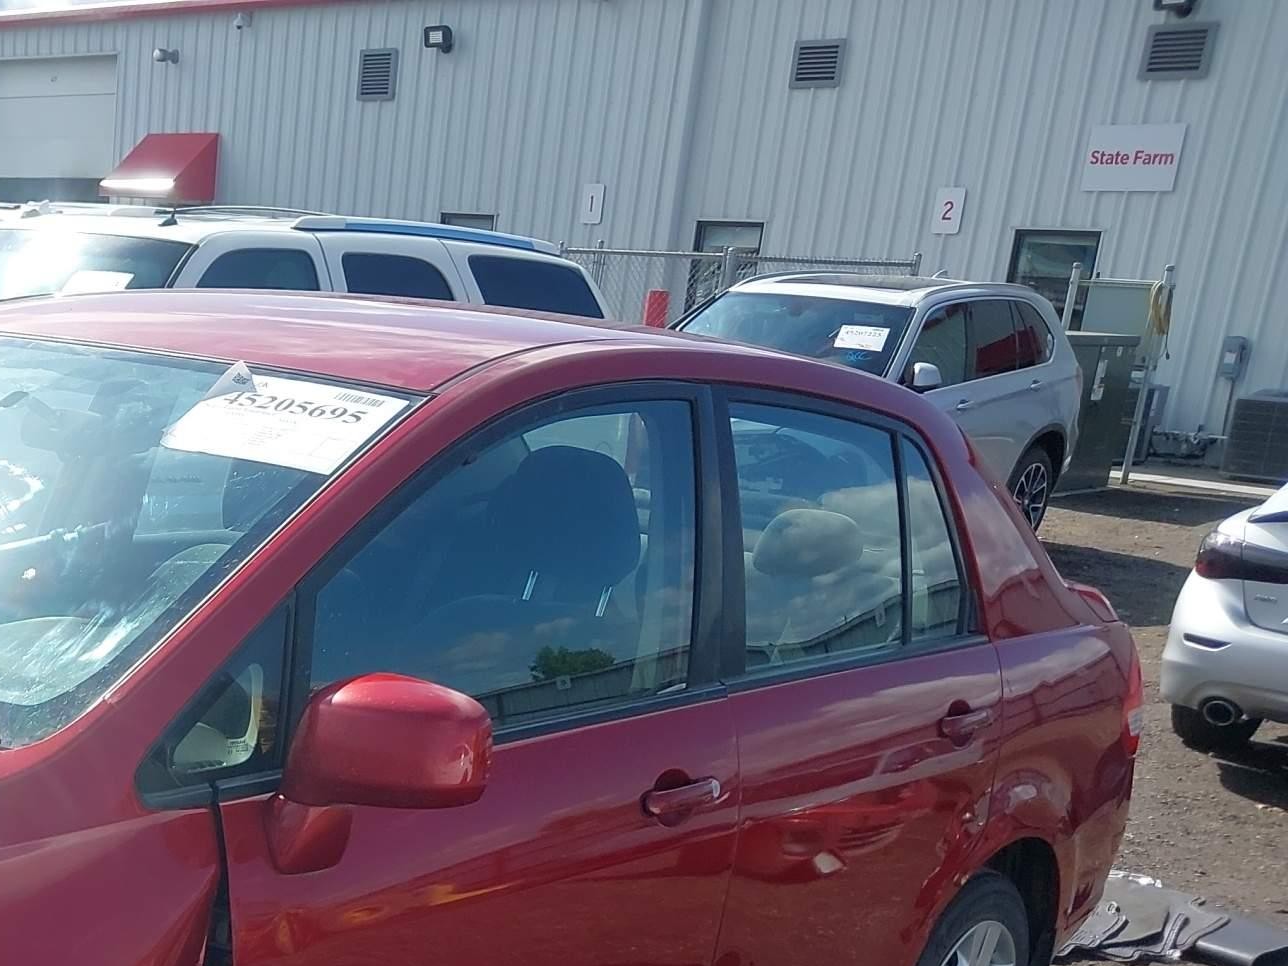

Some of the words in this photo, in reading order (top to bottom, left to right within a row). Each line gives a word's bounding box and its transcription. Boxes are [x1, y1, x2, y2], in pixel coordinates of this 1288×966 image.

[1090, 150, 1129, 165] State
[1133, 150, 1174, 165] Farm
[941, 200, 954, 221] 2
[223, 391, 369, 424] 45205695
